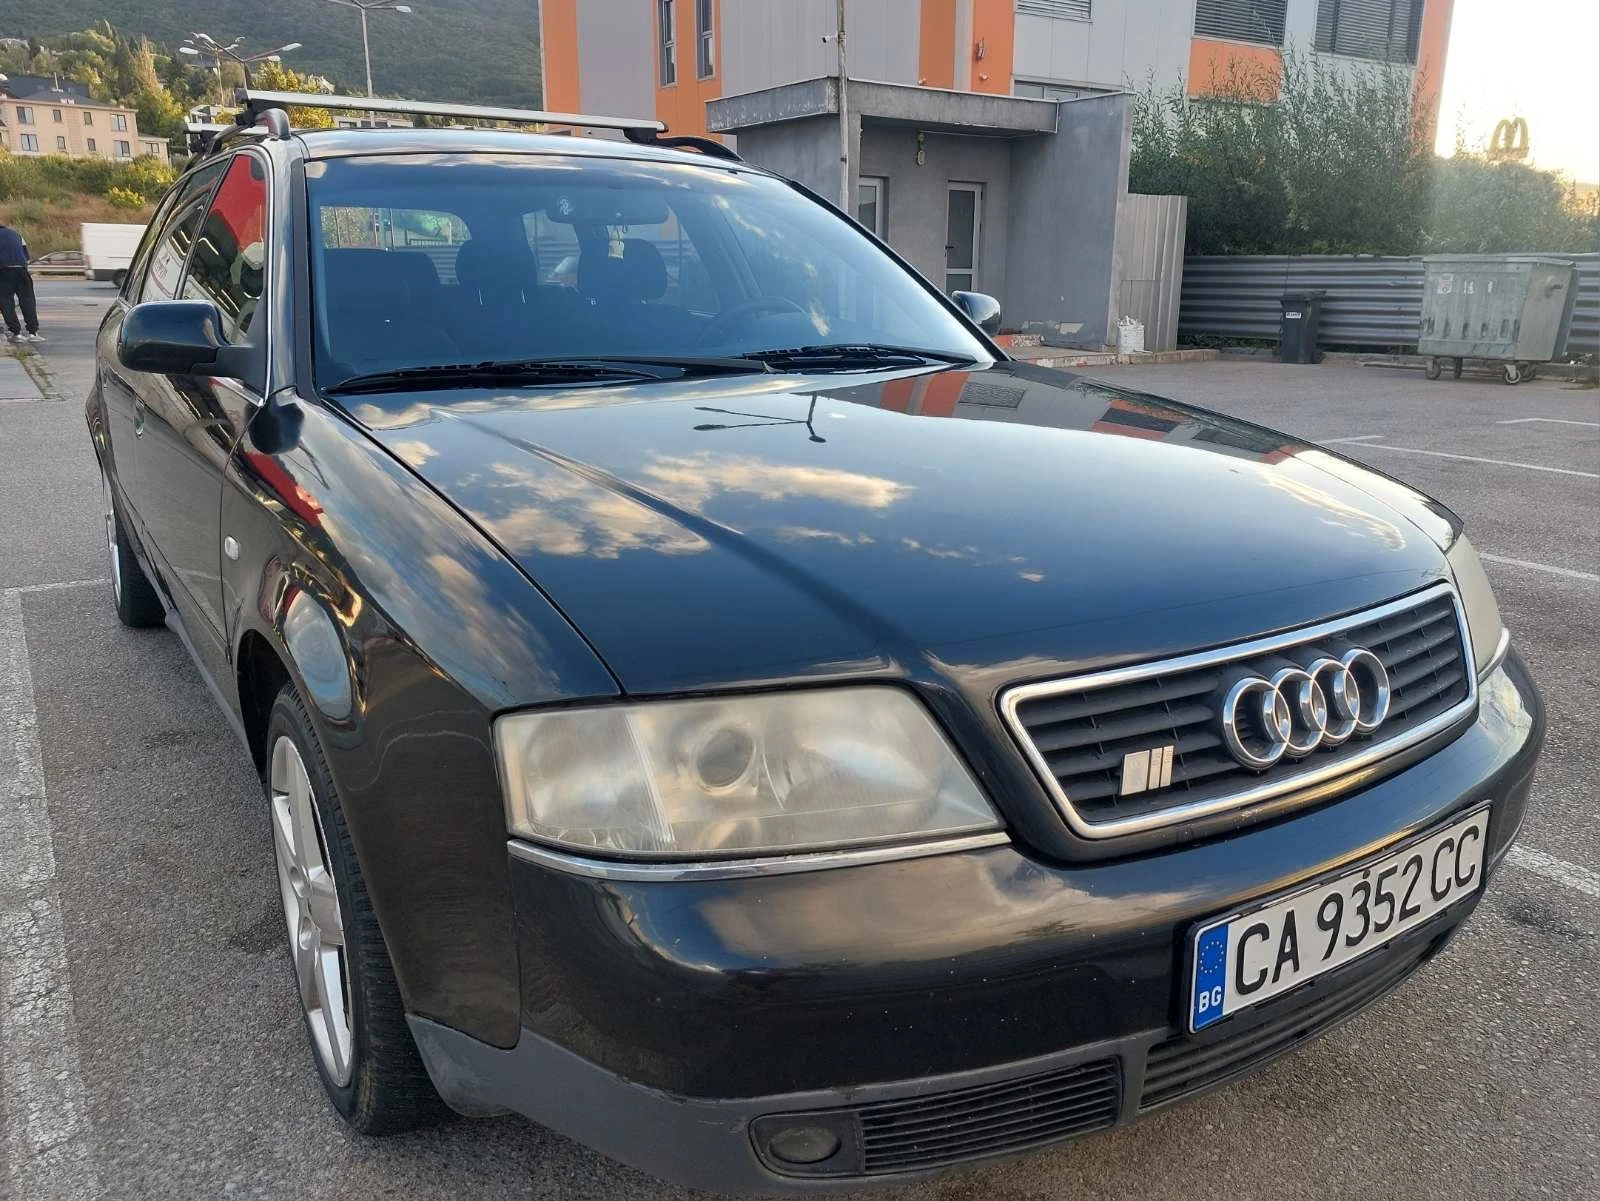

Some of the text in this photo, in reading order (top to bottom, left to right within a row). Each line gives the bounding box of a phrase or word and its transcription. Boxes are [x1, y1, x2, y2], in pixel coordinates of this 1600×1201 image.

[1235, 825, 1479, 996] CA 9352 CC
[1199, 986, 1222, 1013] BG
